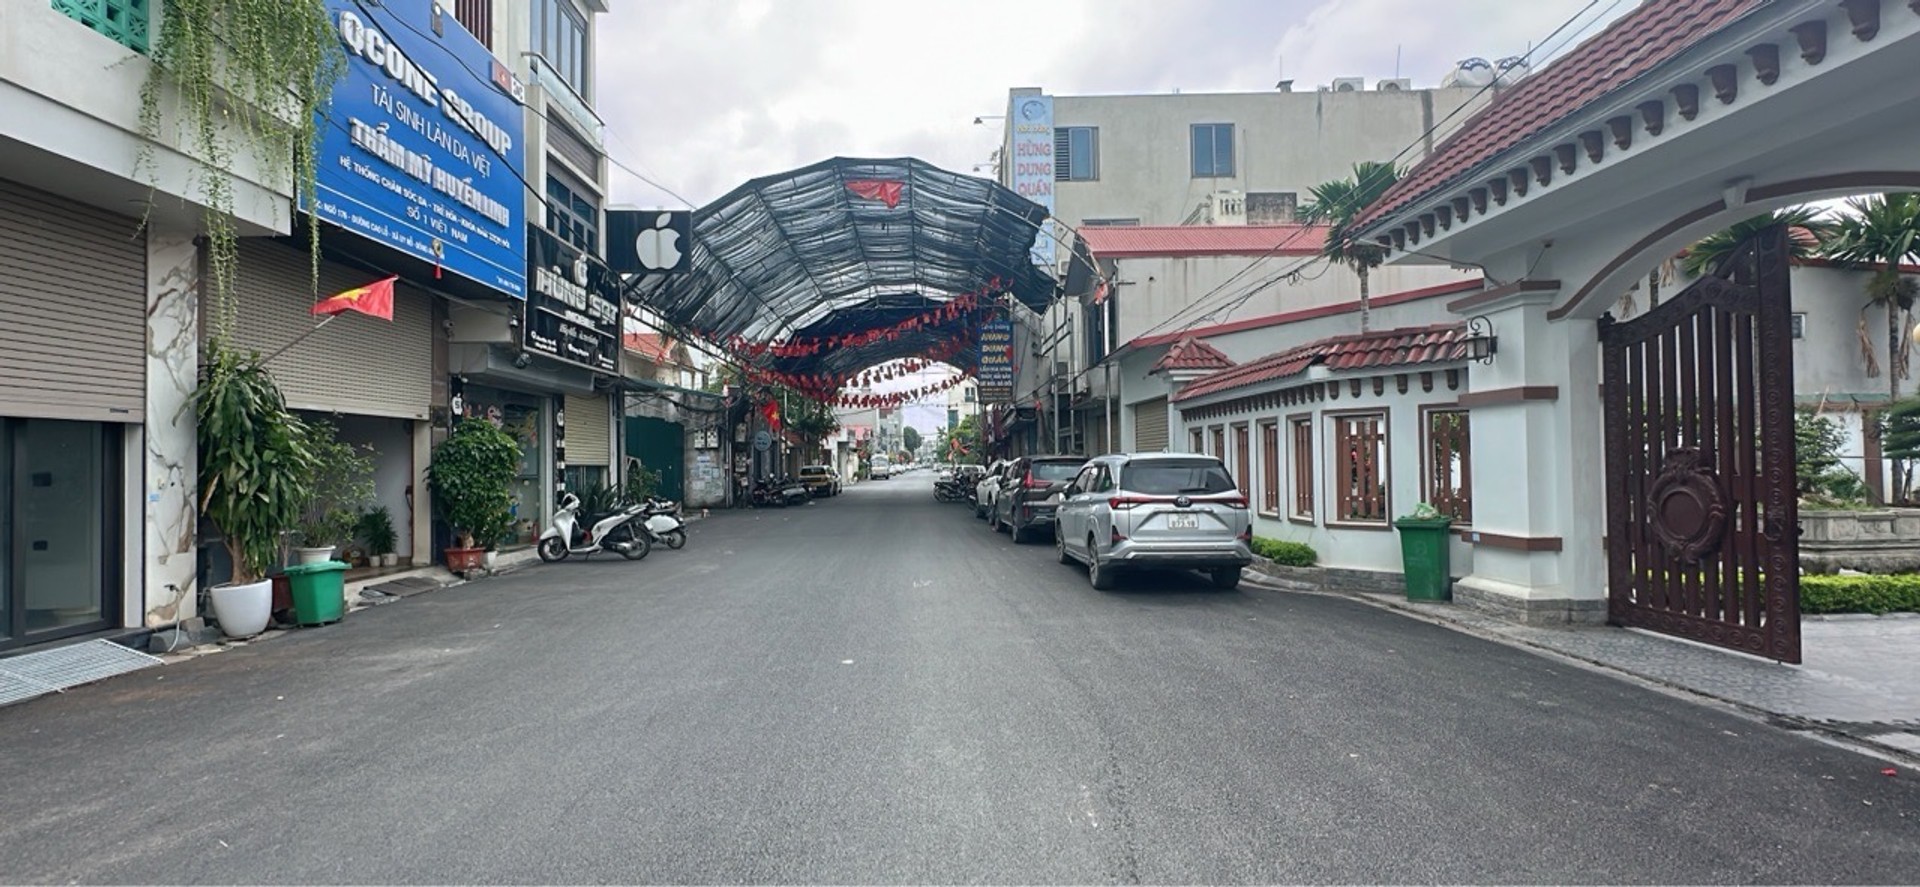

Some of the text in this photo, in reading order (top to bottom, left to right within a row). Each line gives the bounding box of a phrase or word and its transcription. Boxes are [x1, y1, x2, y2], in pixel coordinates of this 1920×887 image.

[339, 11, 512, 157] QCONE GROUP
[395, 101, 425, 136] SINH
[427, 122, 451, 153] LÀN
[453, 141, 470, 165] DA
[471, 151, 491, 179] VIỆT
[1017, 139, 1051, 156] HÙNG
[1017, 162, 1051, 176] DUNG
[407, 205, 420, 221] SỐ
[423, 214, 427, 225] 1
[451, 227, 468, 244] NAM
[536, 265, 586, 311] HÙNG
